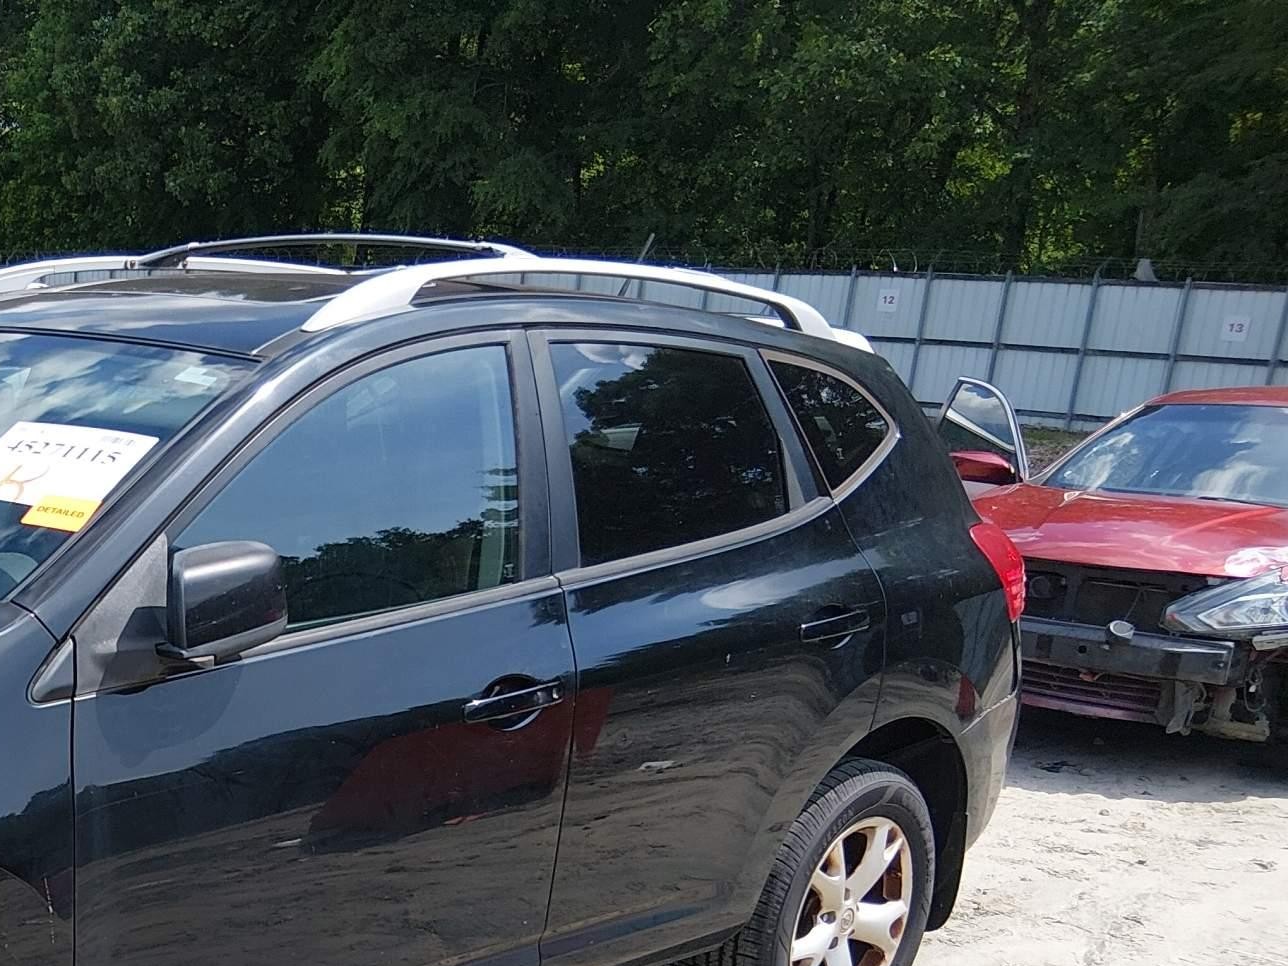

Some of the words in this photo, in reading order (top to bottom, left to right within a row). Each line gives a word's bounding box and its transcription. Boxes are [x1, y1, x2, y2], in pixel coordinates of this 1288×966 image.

[882, 295, 895, 304] 12
[1228, 323, 1244, 333] 13
[7, 440, 122, 464] 45271115
[36, 505, 85, 518] DETAILED
